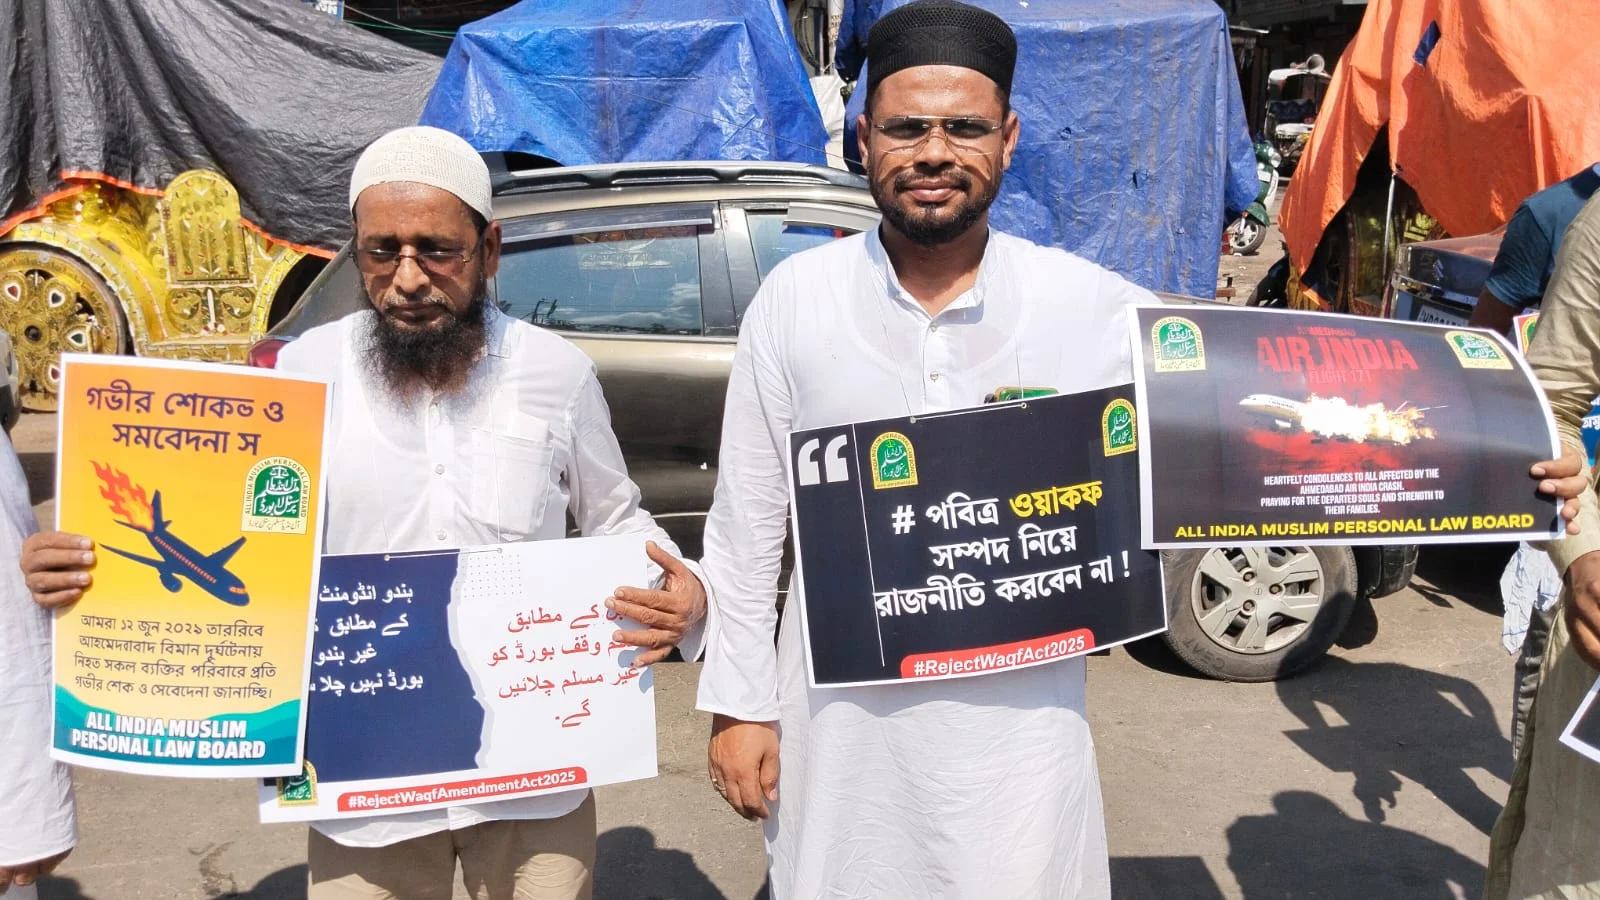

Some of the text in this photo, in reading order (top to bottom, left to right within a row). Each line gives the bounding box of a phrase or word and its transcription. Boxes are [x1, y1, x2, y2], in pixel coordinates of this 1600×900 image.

[1257, 337, 1316, 373] AIR
[1309, 369, 1372, 384] FLIGHT 171
[87, 379, 155, 413] গভীর
[263, 402, 284, 422] ও
[112, 424, 261, 456] সমবেদনা স
[1264, 468, 1439, 486] HEARTFELT CONDOLENCES TO ALL AFFECTED BY THE
[1300, 480, 1405, 495] AHMEDABAD AIR INDIA CRASH.
[1260, 490, 1445, 508] PRAYING FOR THE DEPARTED SOULS AND STRENGTH TO
[1324, 504, 1381, 516] THEIR FAMILIES.
[891, 504, 915, 535] #
[925, 491, 999, 530] পবিত্র
[1175, 513, 1535, 538] ALL INDIA MUSLIM PERSONAL LAW BOARD
[928, 537, 1010, 570] সম্পদ
[319, 582, 414, 605] ہندو انڈومنٹ
[872, 572, 986, 617] রাজনীতি
[993, 564, 1083, 602] করবেন
[1089, 555, 1114, 584] না
[81, 615, 116, 630] আমরা
[121, 619, 133, 631] ১২
[138, 620, 160, 637] জুন
[329, 613, 377, 637] مطابق
[382, 613, 409, 636] کے
[507, 607, 562, 633] مطابق
[570, 604, 600, 629] کے
[160, 638, 201, 656] বিমান
[314, 643, 377, 666] غیر ہندو
[487, 646, 509, 667] کو
[515, 640, 555, 663] بورڈ
[561, 634, 601, 656] وقف
[914, 635, 1085, 676] #RejectWaqfAct2025
[75, 650, 277, 679] নিহত সকল ব্যক্তির পরিবারে প্রতি
[611, 662, 640, 686] غیر
[75, 673, 104, 691] গভীর
[138, 683, 147, 694] ও
[350, 672, 383, 695] نہیں
[387, 669, 424, 690] بورڈ
[561, 670, 603, 695] مسلم
[86, 711, 247, 739] ALL INDIA MUSLIM
[71, 728, 266, 760] PERSONAL LAW BOARD
[347, 770, 576, 808] #RejectWaqfAmendmentAct2025
